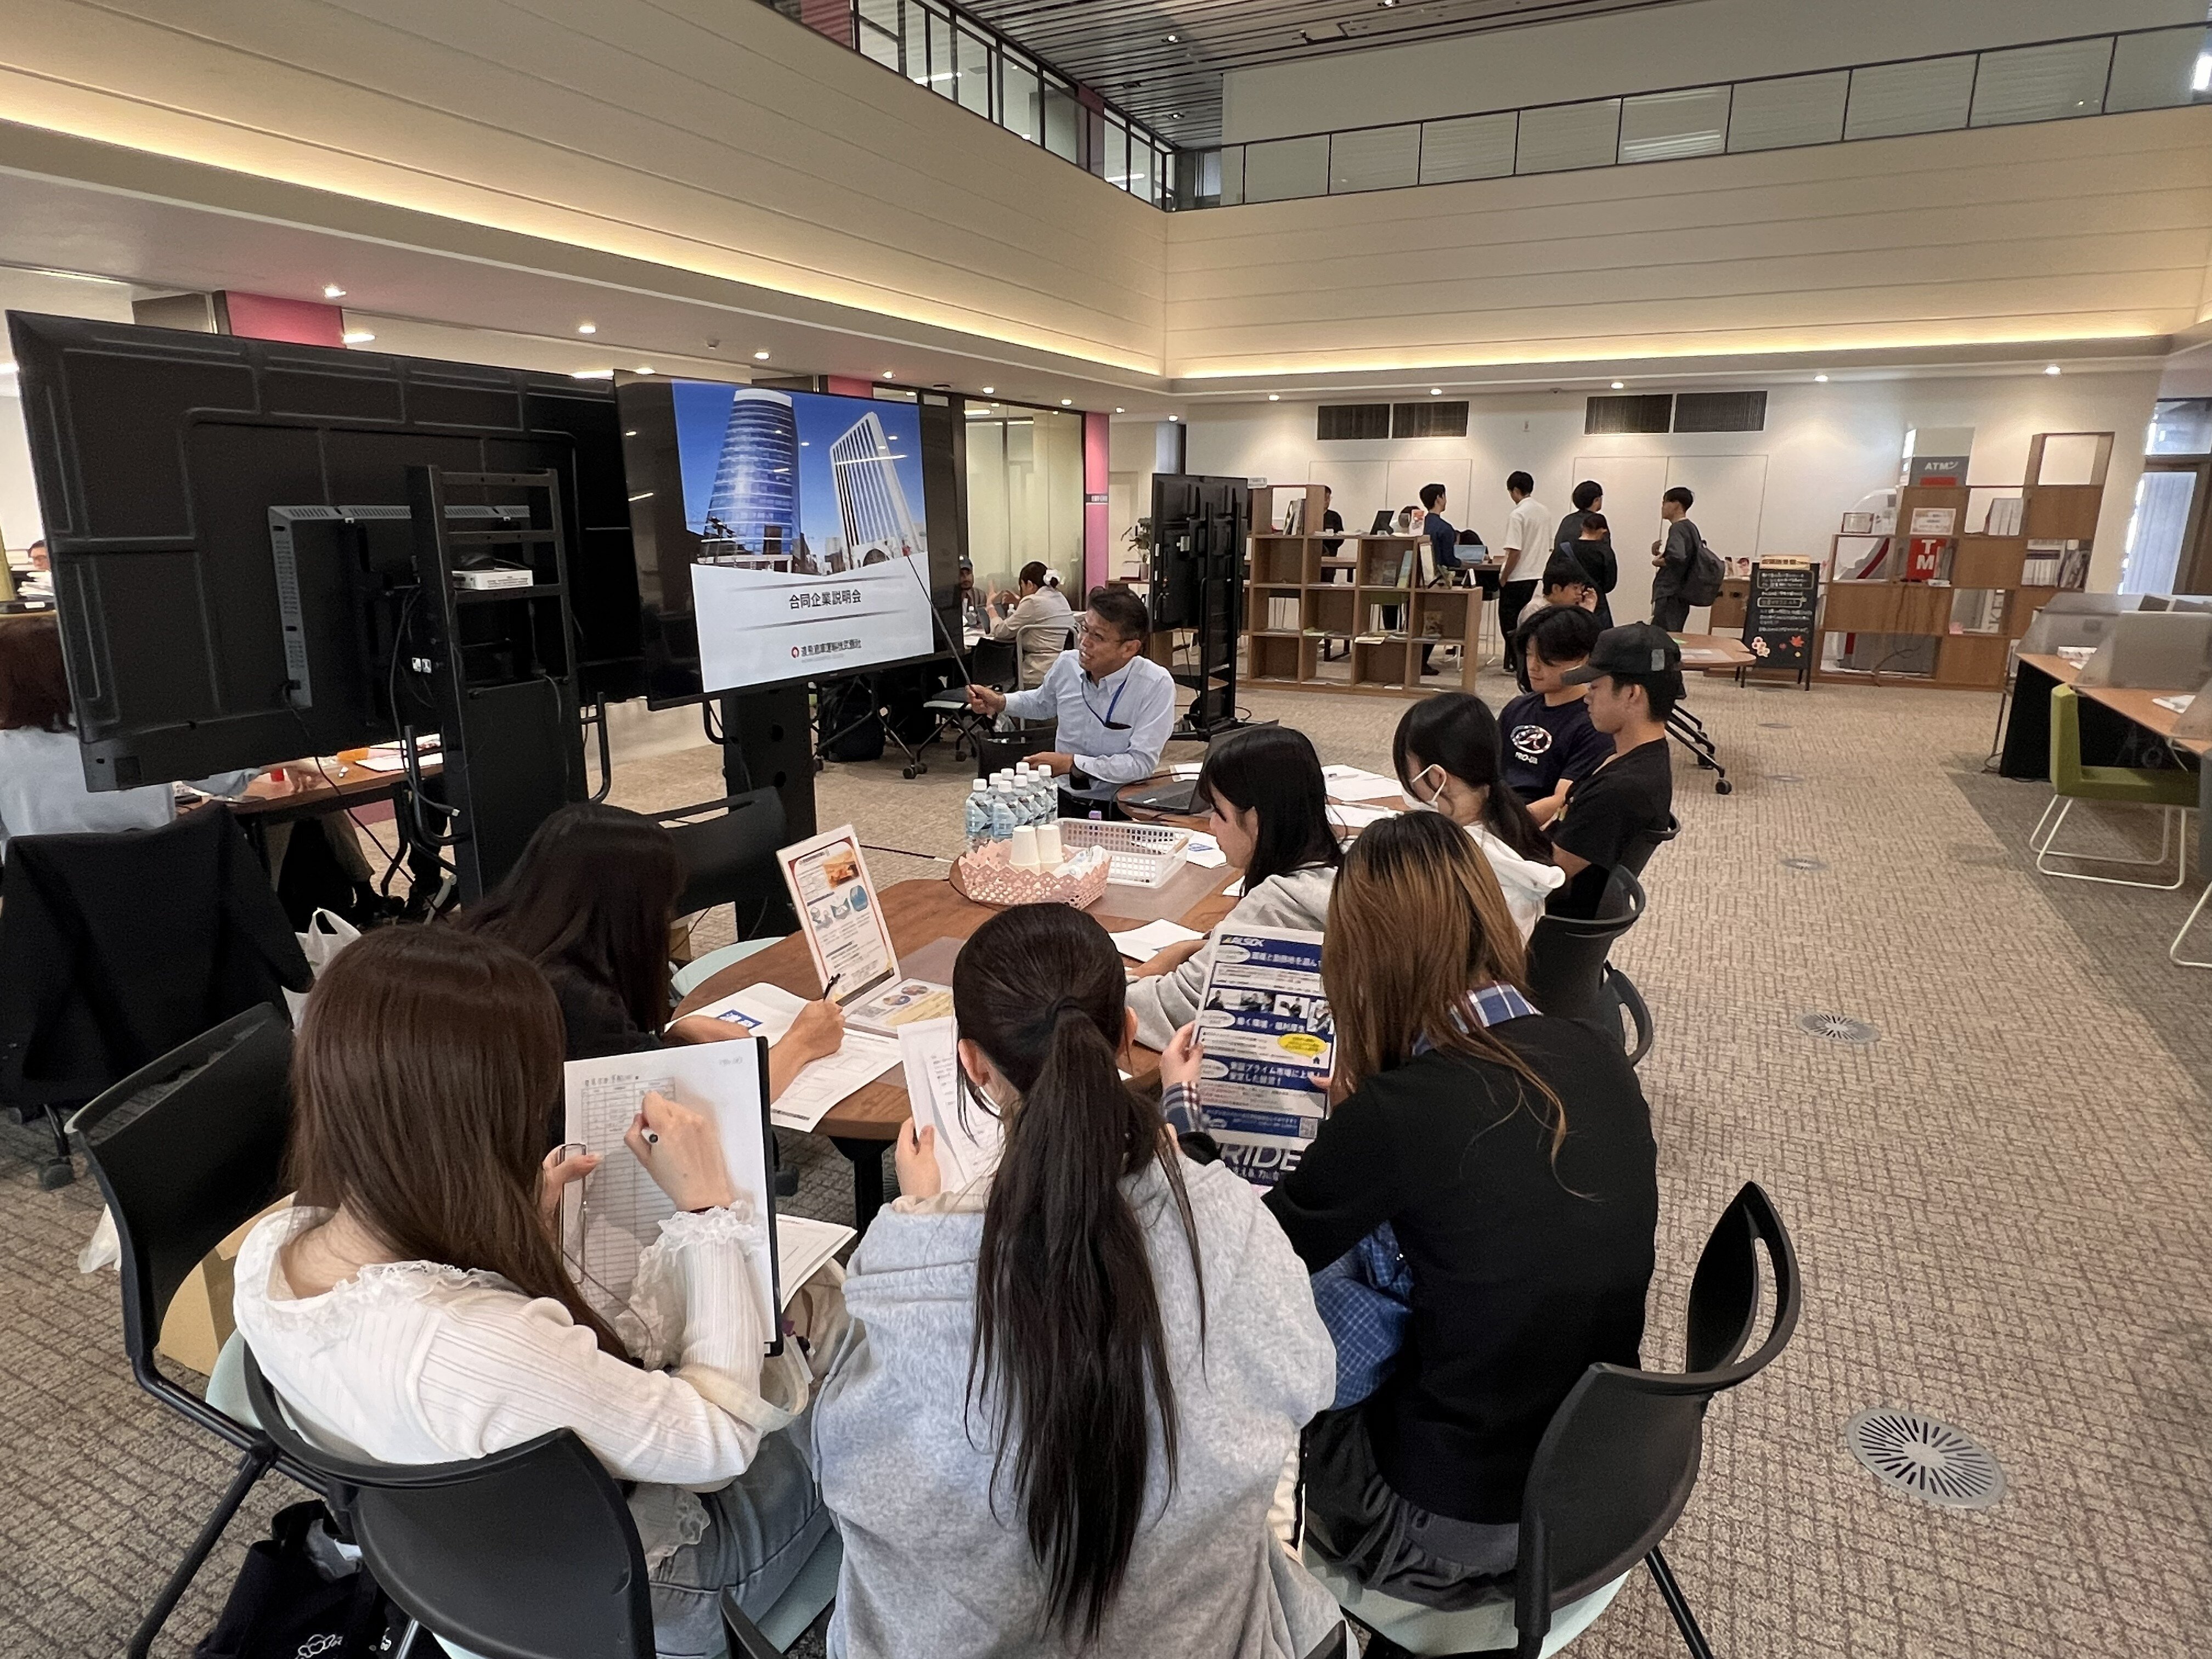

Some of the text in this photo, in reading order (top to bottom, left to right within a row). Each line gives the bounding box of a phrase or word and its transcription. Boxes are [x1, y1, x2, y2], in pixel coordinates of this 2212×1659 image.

[1925, 462, 1949, 471] ATM
[789, 589, 861, 610] 合同企業説明会
[1218, 1142, 1301, 1171] RIDE
